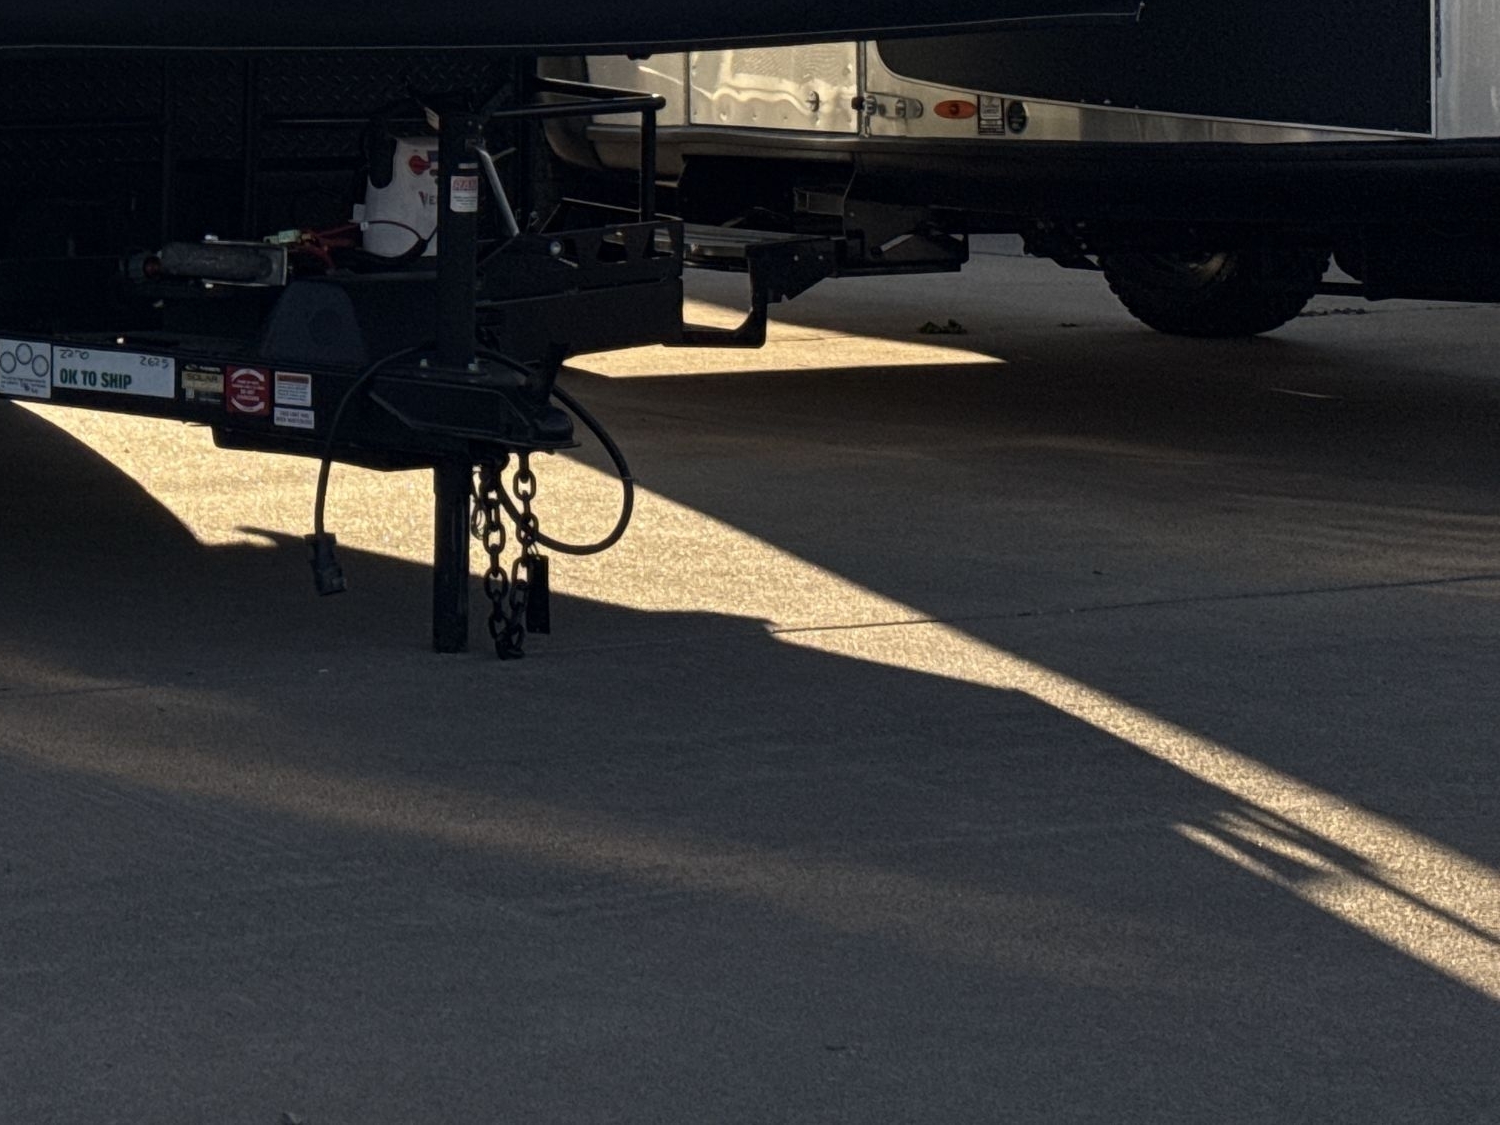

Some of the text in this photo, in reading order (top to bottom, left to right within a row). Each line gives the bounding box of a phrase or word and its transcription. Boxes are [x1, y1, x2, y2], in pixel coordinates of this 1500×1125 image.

[60, 368, 78, 385] OK
[81, 370, 97, 386] TO
[100, 371, 132, 390] SHIP
